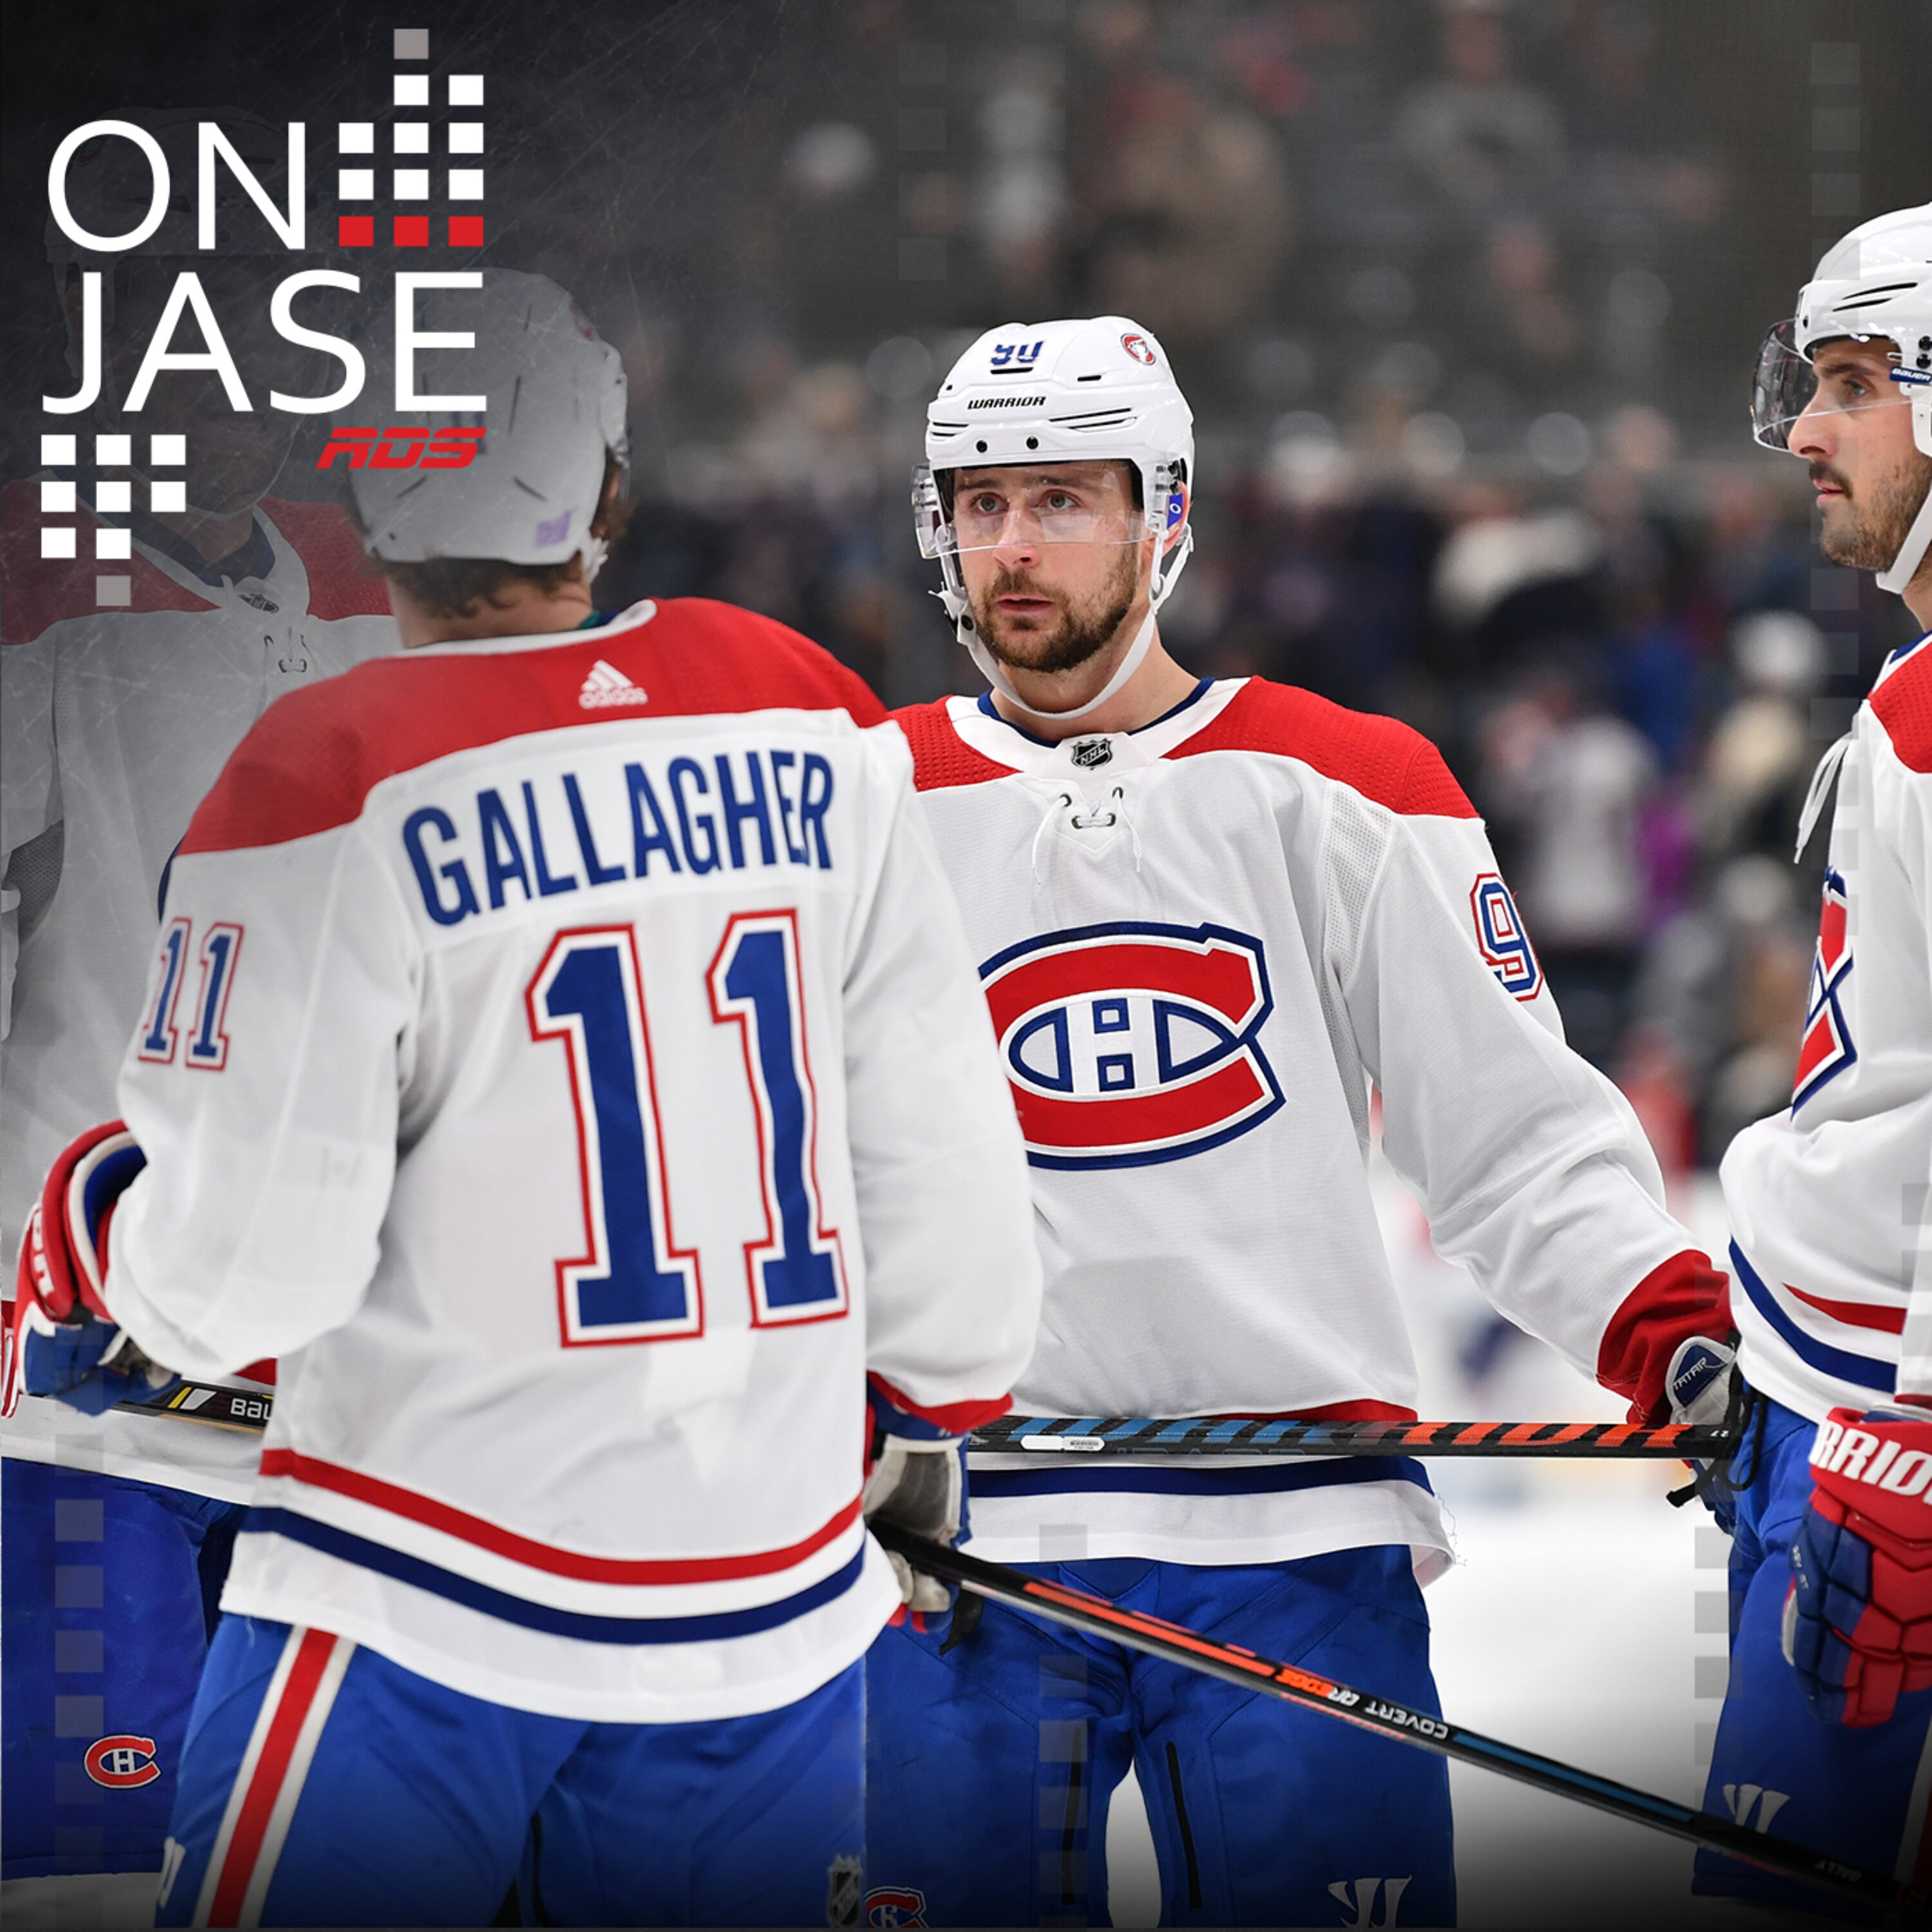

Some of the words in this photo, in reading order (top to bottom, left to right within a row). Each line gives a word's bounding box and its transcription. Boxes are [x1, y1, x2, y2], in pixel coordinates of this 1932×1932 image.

[967, 395, 1046, 410] WARRIOR
[578, 685, 649, 710] adidas
[402, 750, 833, 926] GALLAGHER
[137, 917, 245, 1071] 11
[524, 908, 850, 1349] 11
[1808, 1419, 1932, 1507] RRIO
[1364, 1701, 1449, 1740] COVERT
